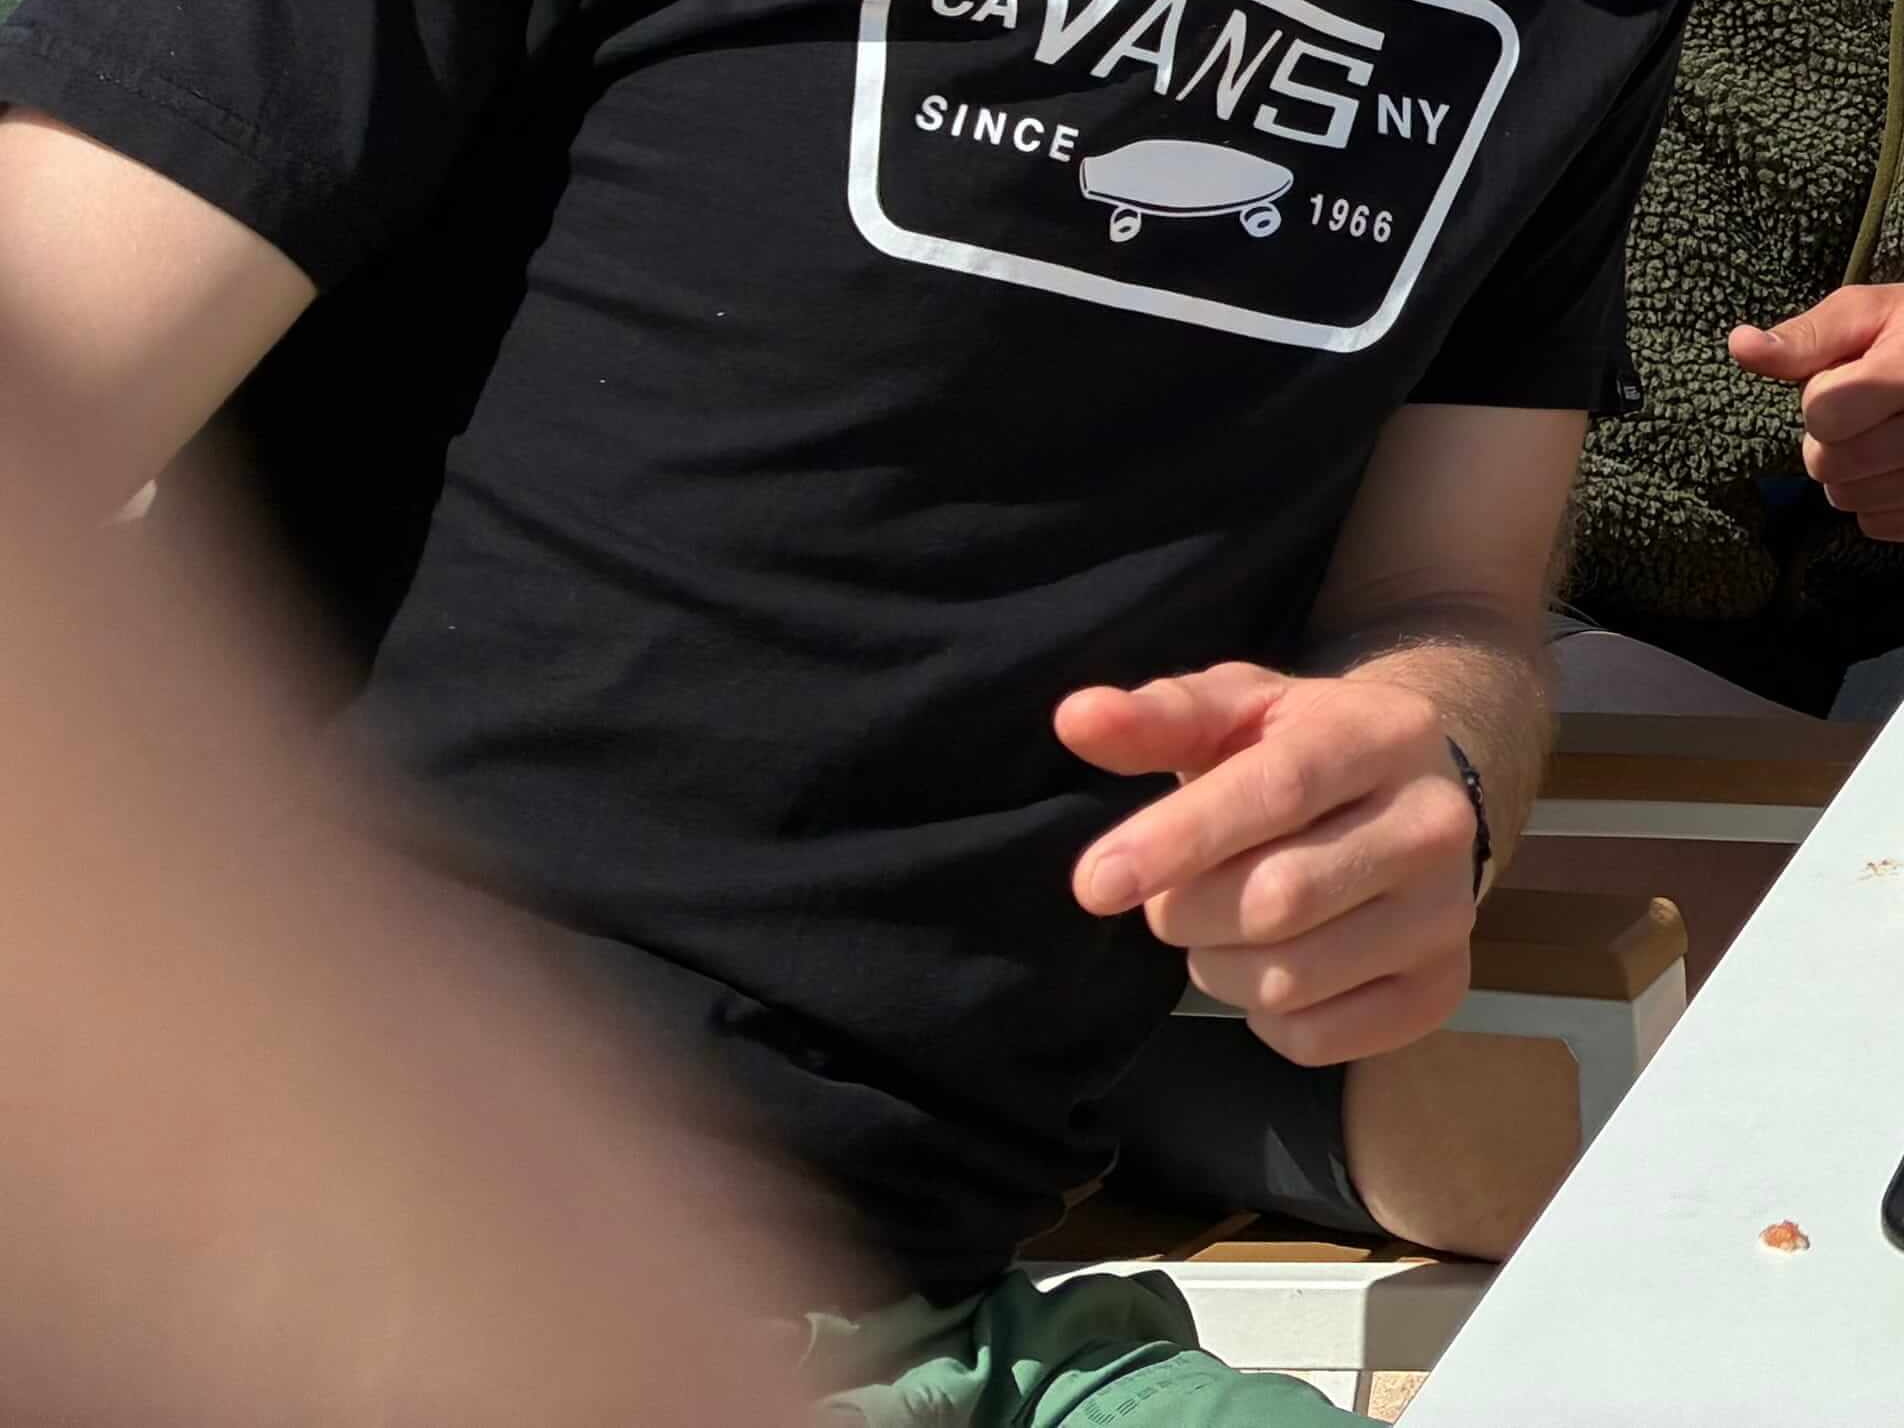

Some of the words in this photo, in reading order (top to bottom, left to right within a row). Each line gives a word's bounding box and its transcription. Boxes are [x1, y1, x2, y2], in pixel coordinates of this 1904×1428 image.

[915, 94, 1081, 162] SINCE
[1376, 92, 1451, 146] NY
[1309, 192, 1394, 243] 1966
